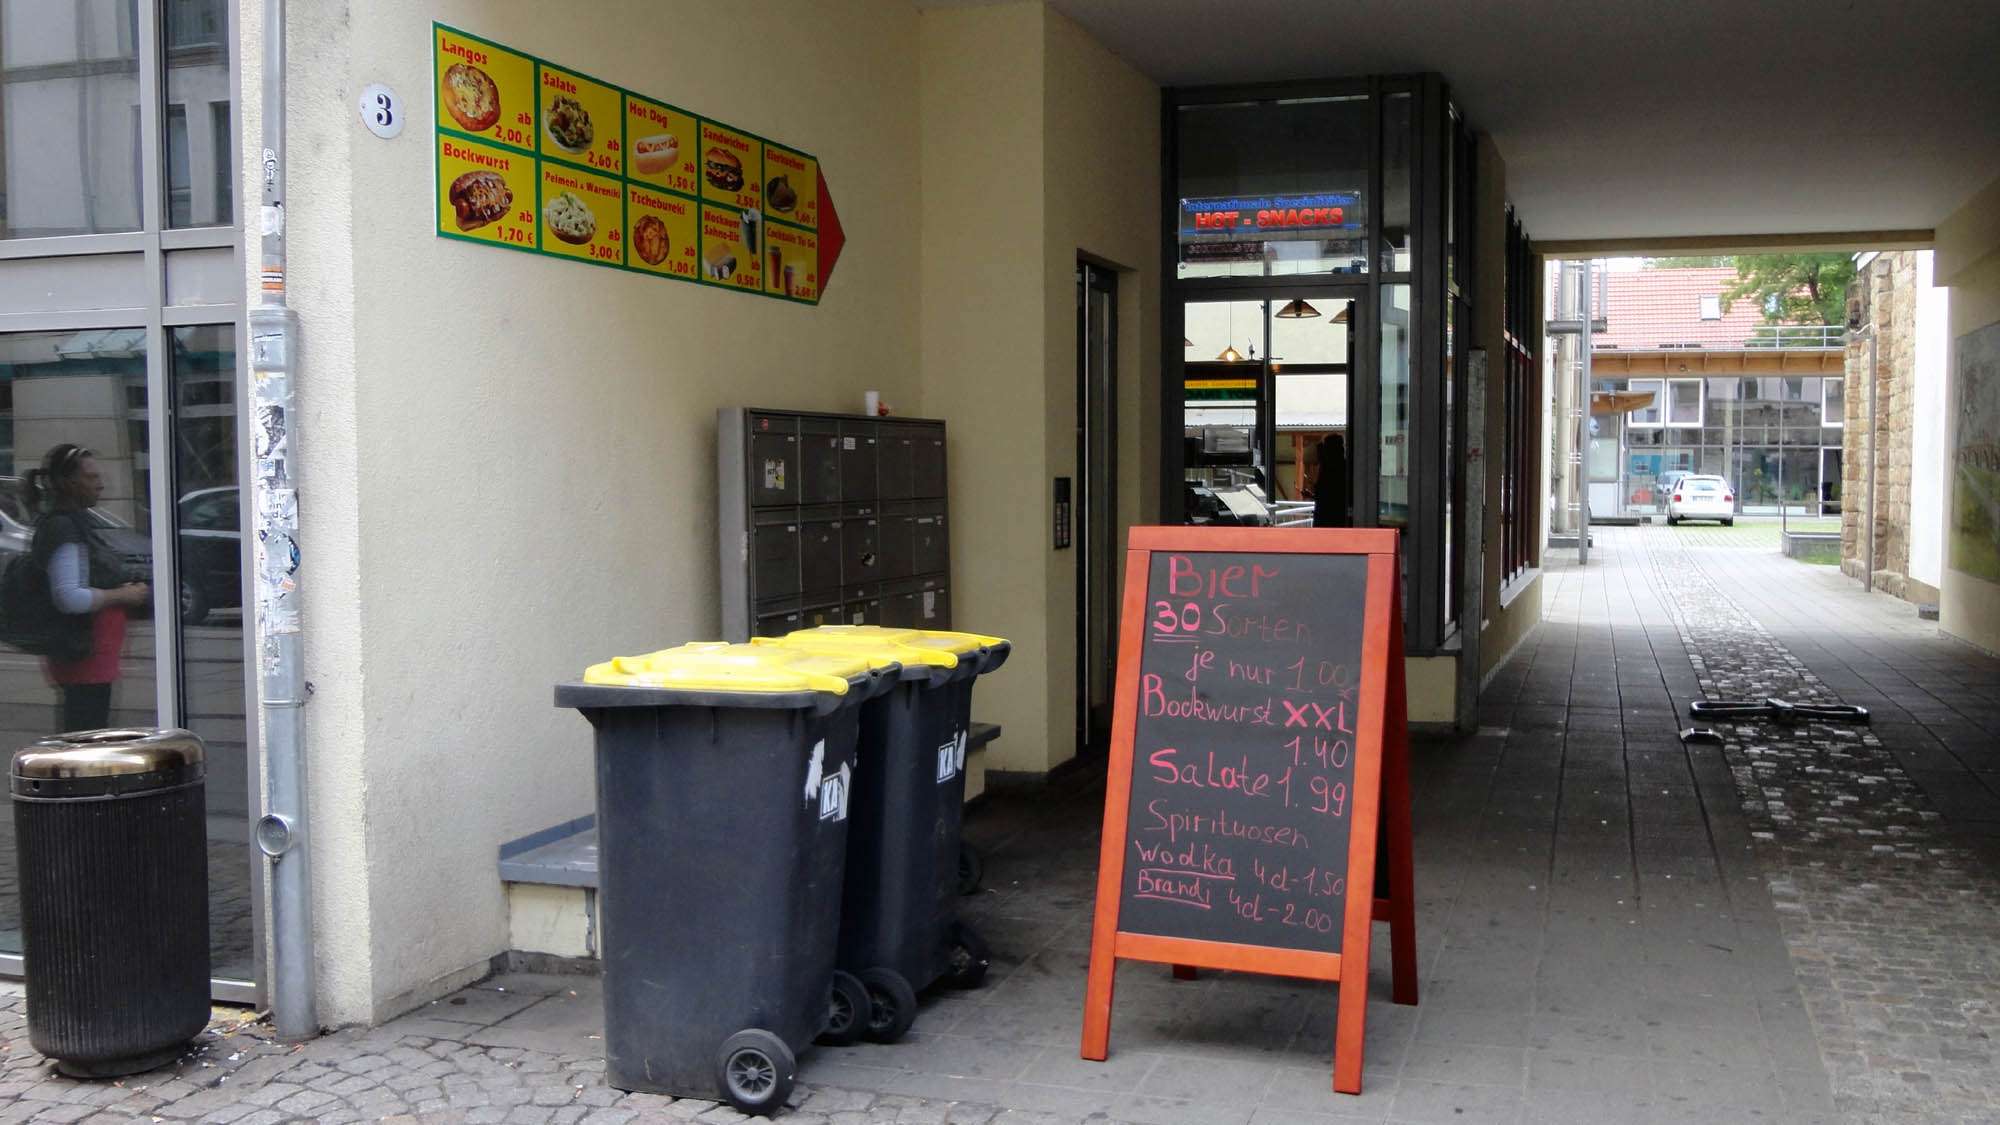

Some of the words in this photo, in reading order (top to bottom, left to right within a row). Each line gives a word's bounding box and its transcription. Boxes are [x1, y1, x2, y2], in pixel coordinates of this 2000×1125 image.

[442, 38, 488, 64] Langos
[543, 72, 577, 94] Salate
[376, 93, 393, 126] 3
[517, 112, 531, 125] ab
[629, 101, 647, 118] Hot
[650, 108, 668, 129] Dog
[495, 125, 522, 143] 2,00
[607, 139, 620, 151] ab
[703, 127, 750, 153] Sandwiches
[443, 142, 510, 171] Bockwurst
[684, 163, 695, 174] ab
[545, 171, 578, 189] Pelmeni
[586, 182, 621, 200] Wareniki
[667, 174, 688, 190] 1,50
[750, 183, 760, 193] ab
[630, 191, 686, 216] Tschebureki
[519, 211, 533, 223] ab
[1195, 211, 1240, 229] HOT
[1256, 207, 1344, 229] SNACKS
[497, 226, 524, 242] 1,70
[608, 230, 621, 242] ab
[590, 244, 613, 259] 3,00
[685, 246, 696, 257] ab
[668, 260, 689, 274] 1,00
[751, 260, 760, 270] ab
[1168, 555, 1281, 599] Bier
[1152, 601, 1200, 633] 30
[1205, 603, 1312, 643] Sorten
[1185, 645, 1215, 681] je
[1229, 660, 1275, 685] nur
[1143, 674, 1277, 725] Bockwurst
[1283, 735, 1348, 769] 1.40
[1150, 748, 1270, 797] Salate
[1277, 766, 1347, 817] 1.99
[1144, 799, 1309, 849] Spirituosen
